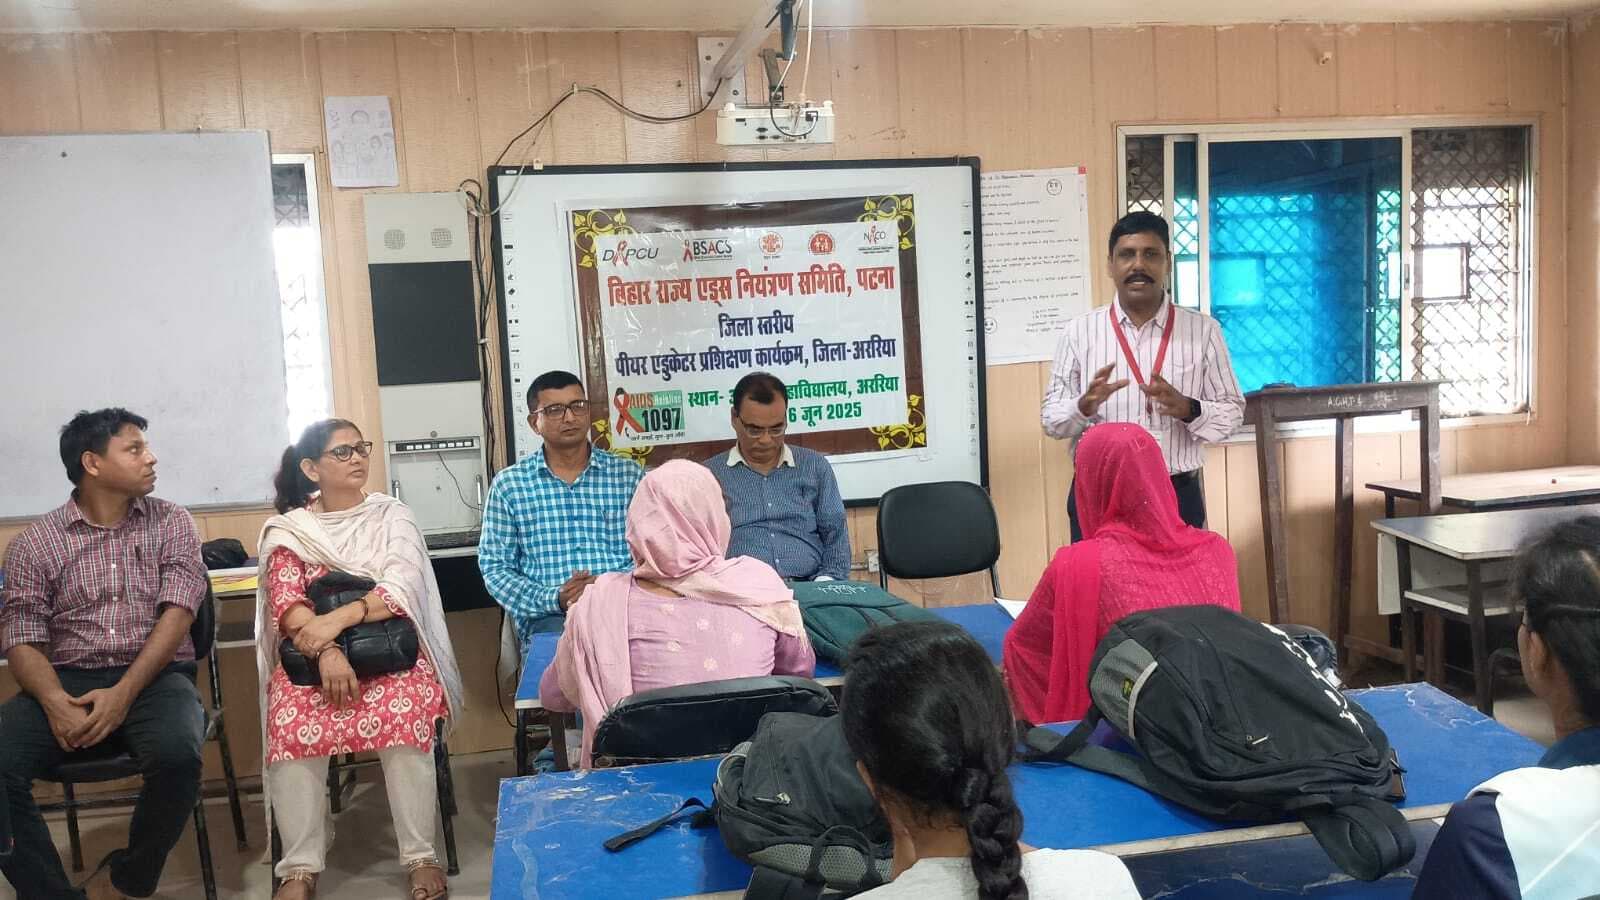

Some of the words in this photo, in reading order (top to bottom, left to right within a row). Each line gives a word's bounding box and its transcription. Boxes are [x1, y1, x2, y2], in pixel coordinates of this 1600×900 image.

[607, 275, 651, 307] बिहार
[655, 278, 692, 304] राज्य
[696, 276, 733, 307] एड्स
[735, 266, 794, 299] नियंत्रण
[797, 263, 852, 298] समिति,
[856, 266, 895, 291] पटना
[718, 313, 753, 338] जिला
[757, 310, 794, 336] स्तरीय
[615, 352, 648, 377] पीयर
[652, 348, 697, 382] एडुकेटर
[699, 346, 752, 372] प्रशिक्षण
[755, 340, 809, 369] कार्यक्रम,
[784, 380, 852, 399] हाविद्यालय,
[857, 373, 899, 395] अररिया
[629, 393, 653, 408] AIDS
[641, 407, 681, 432] 1097
[801, 405, 823, 427] जून
[826, 402, 862, 419] 2025
